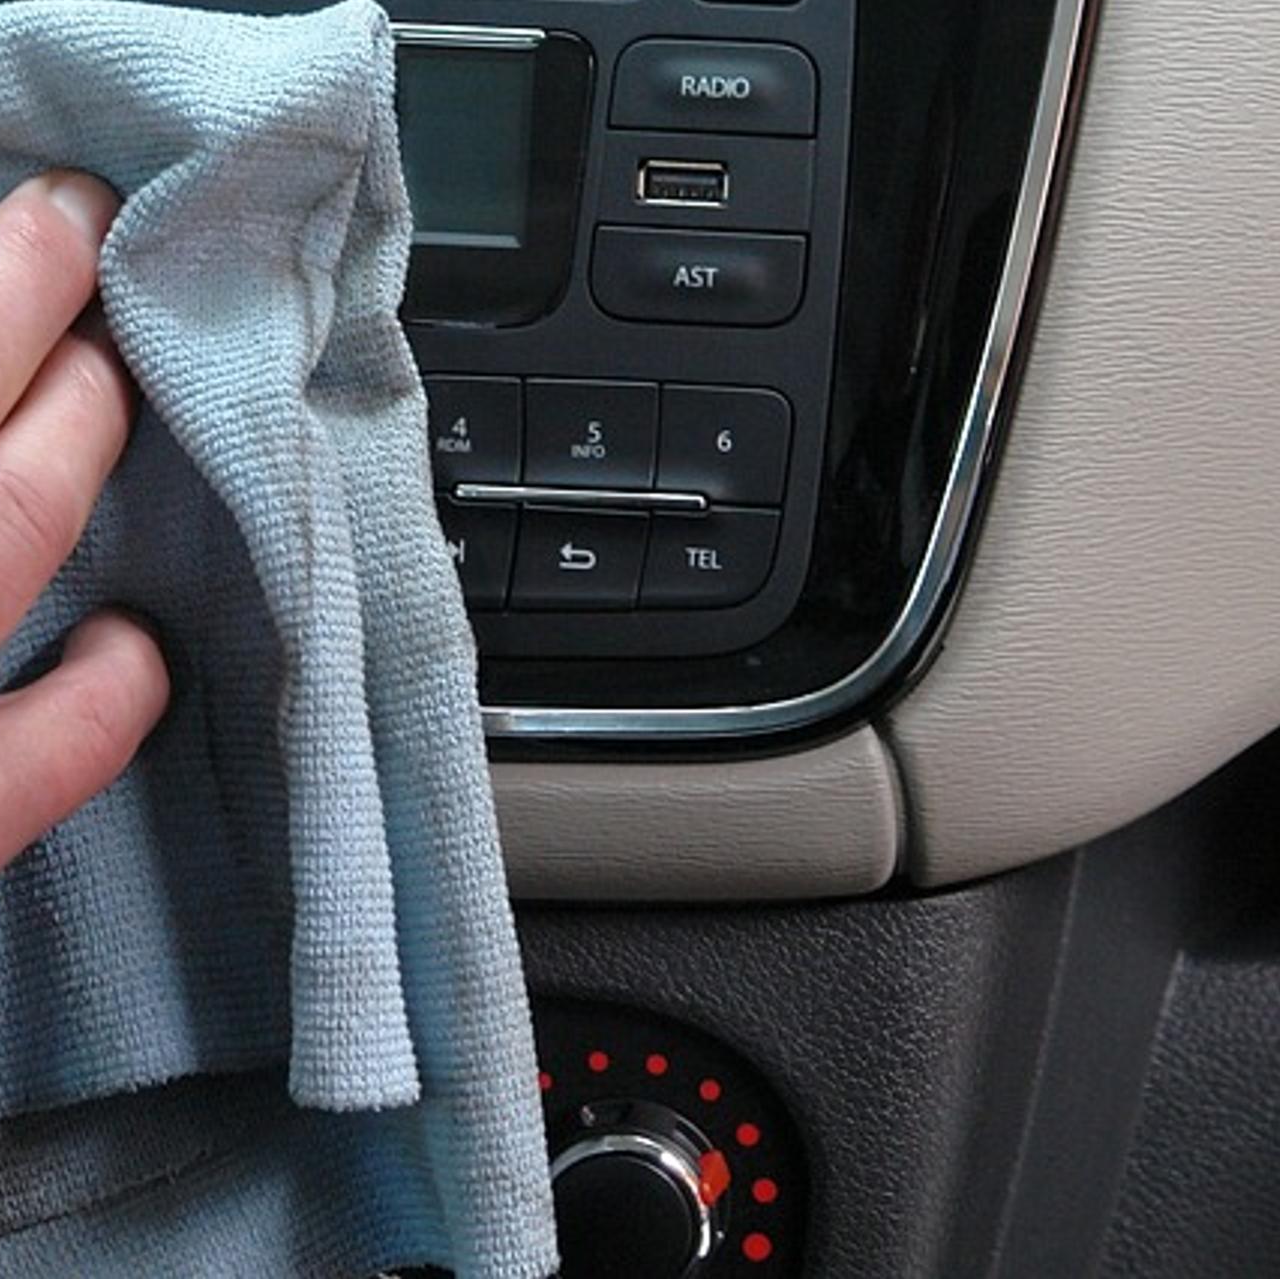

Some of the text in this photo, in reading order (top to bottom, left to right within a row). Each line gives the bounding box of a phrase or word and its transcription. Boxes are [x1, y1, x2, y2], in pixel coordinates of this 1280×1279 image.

[681, 75, 751, 99] RADIO
[673, 265, 719, 288] AST
[451, 417, 467, 438] 4
[588, 420, 602, 444] 5
[570, 444, 607, 459] INFO
[717, 429, 732, 452] 6
[684, 547, 723, 570] TEL
